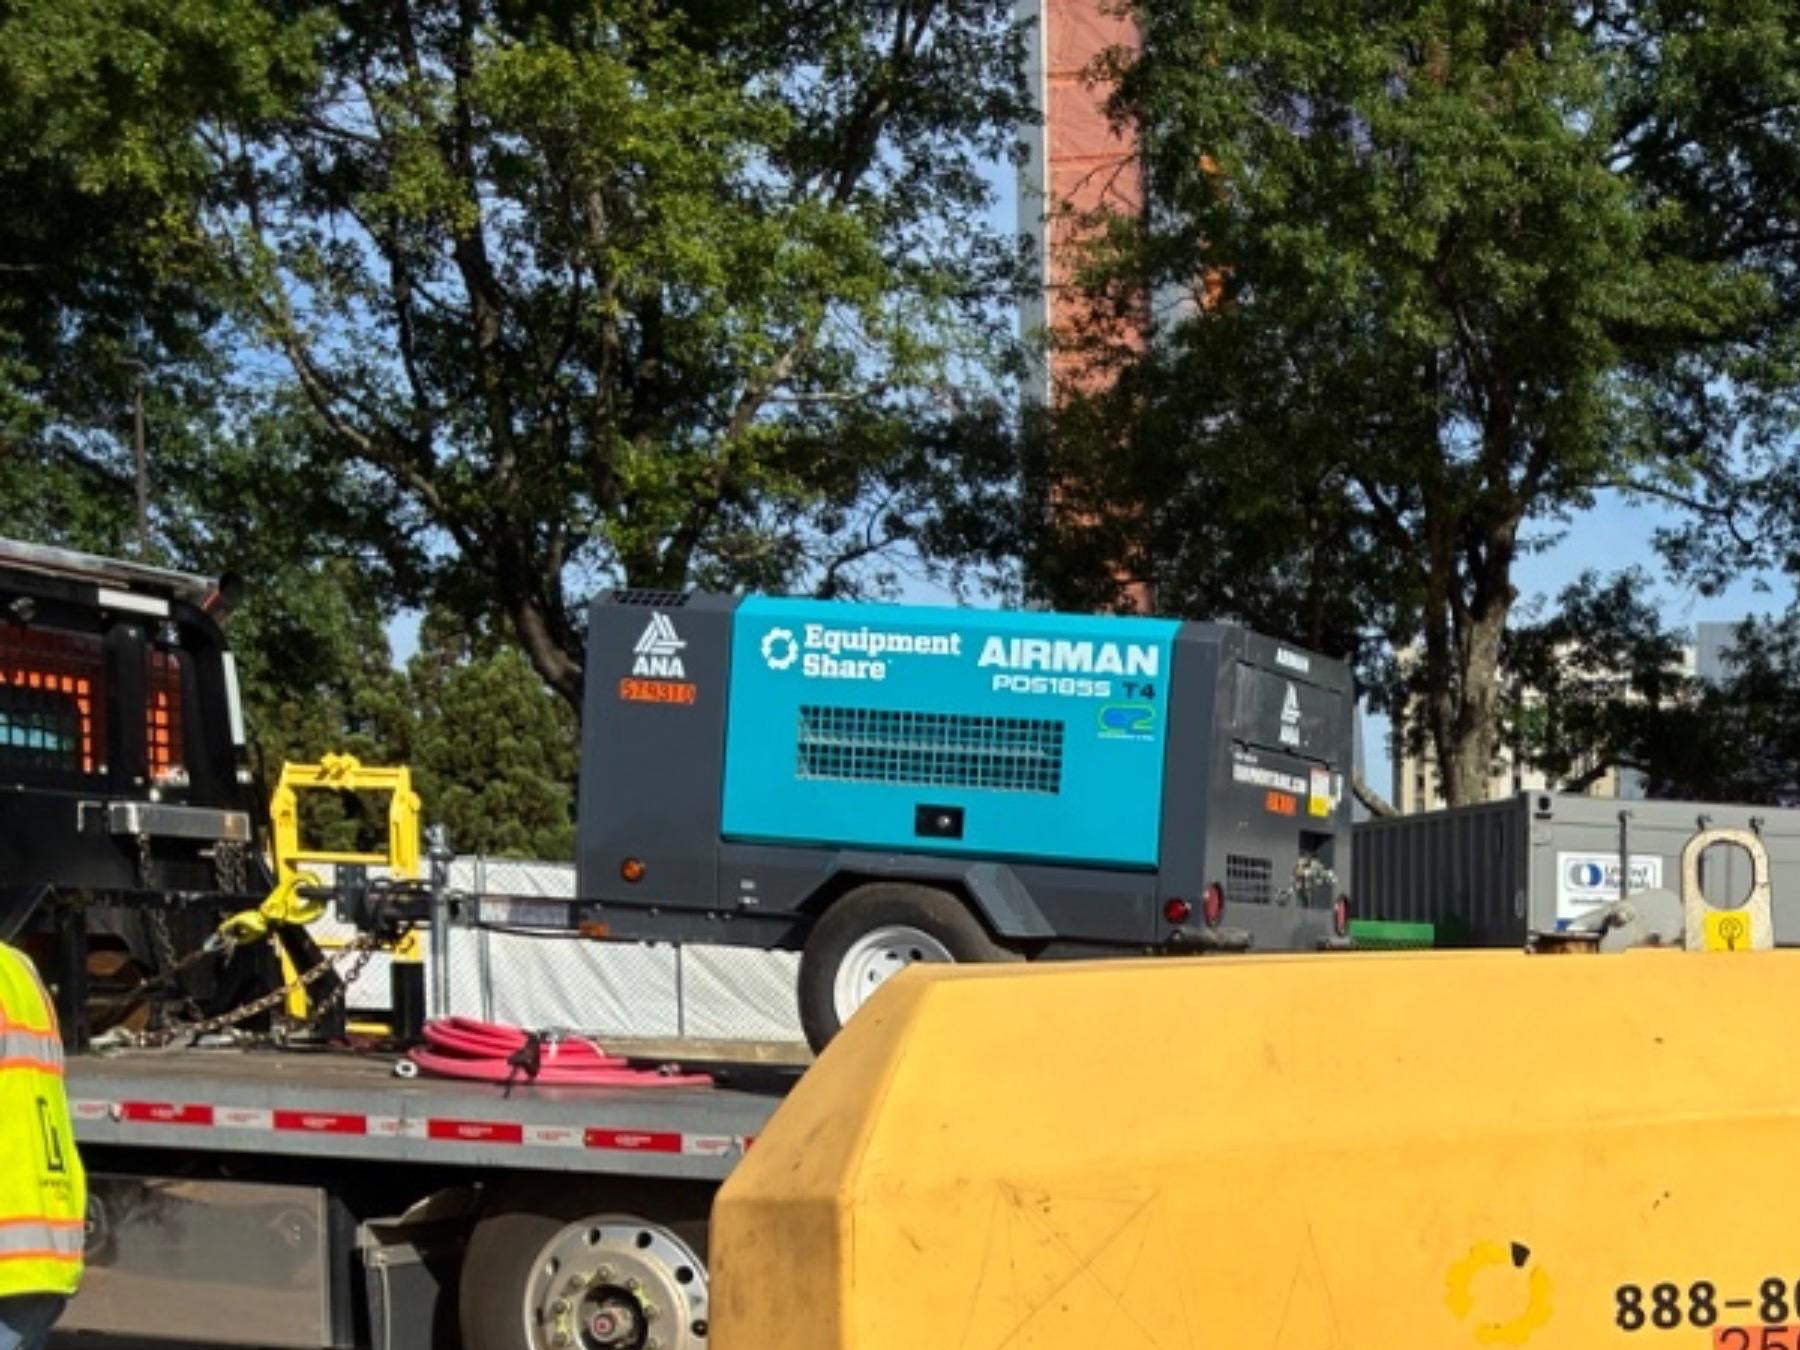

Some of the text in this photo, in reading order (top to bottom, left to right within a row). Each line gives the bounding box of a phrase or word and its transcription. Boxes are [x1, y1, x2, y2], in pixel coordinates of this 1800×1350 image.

[803, 623, 962, 658] Equipment
[977, 634, 1160, 677] AIRMAN
[632, 654, 686, 680] ANA
[803, 652, 887, 681] Share
